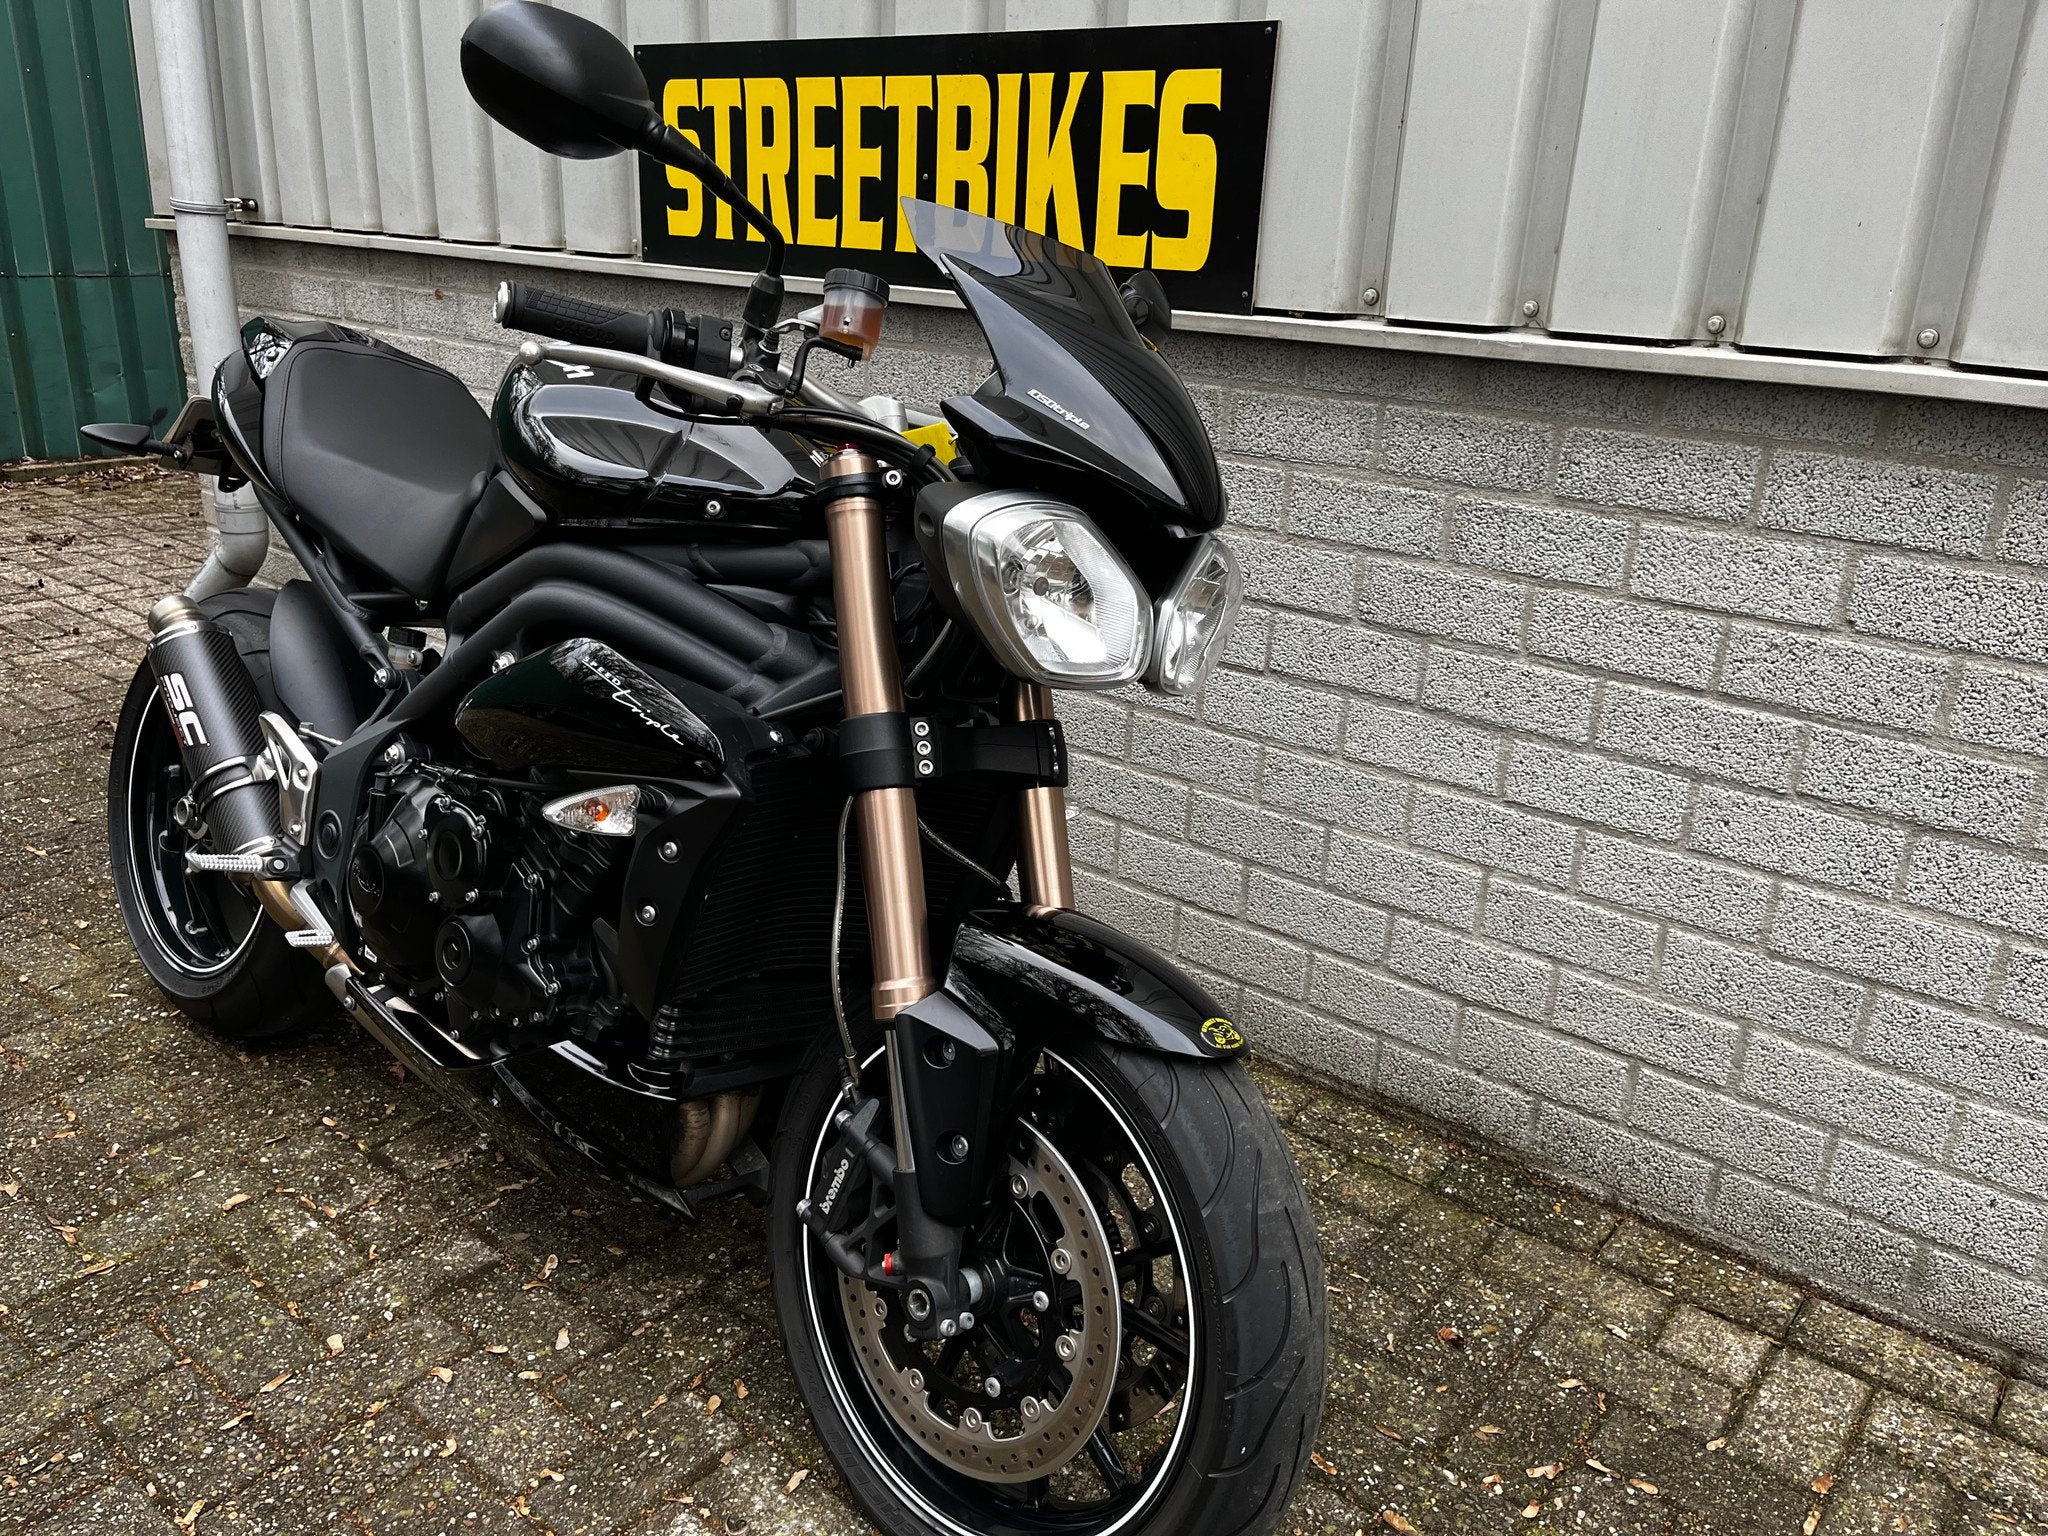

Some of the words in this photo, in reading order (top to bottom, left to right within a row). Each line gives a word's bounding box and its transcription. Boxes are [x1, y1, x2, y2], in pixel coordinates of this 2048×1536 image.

[663, 68, 1222, 271] STREETBIKES
[163, 672, 208, 746] SC
[819, 1158, 849, 1215] brembo
